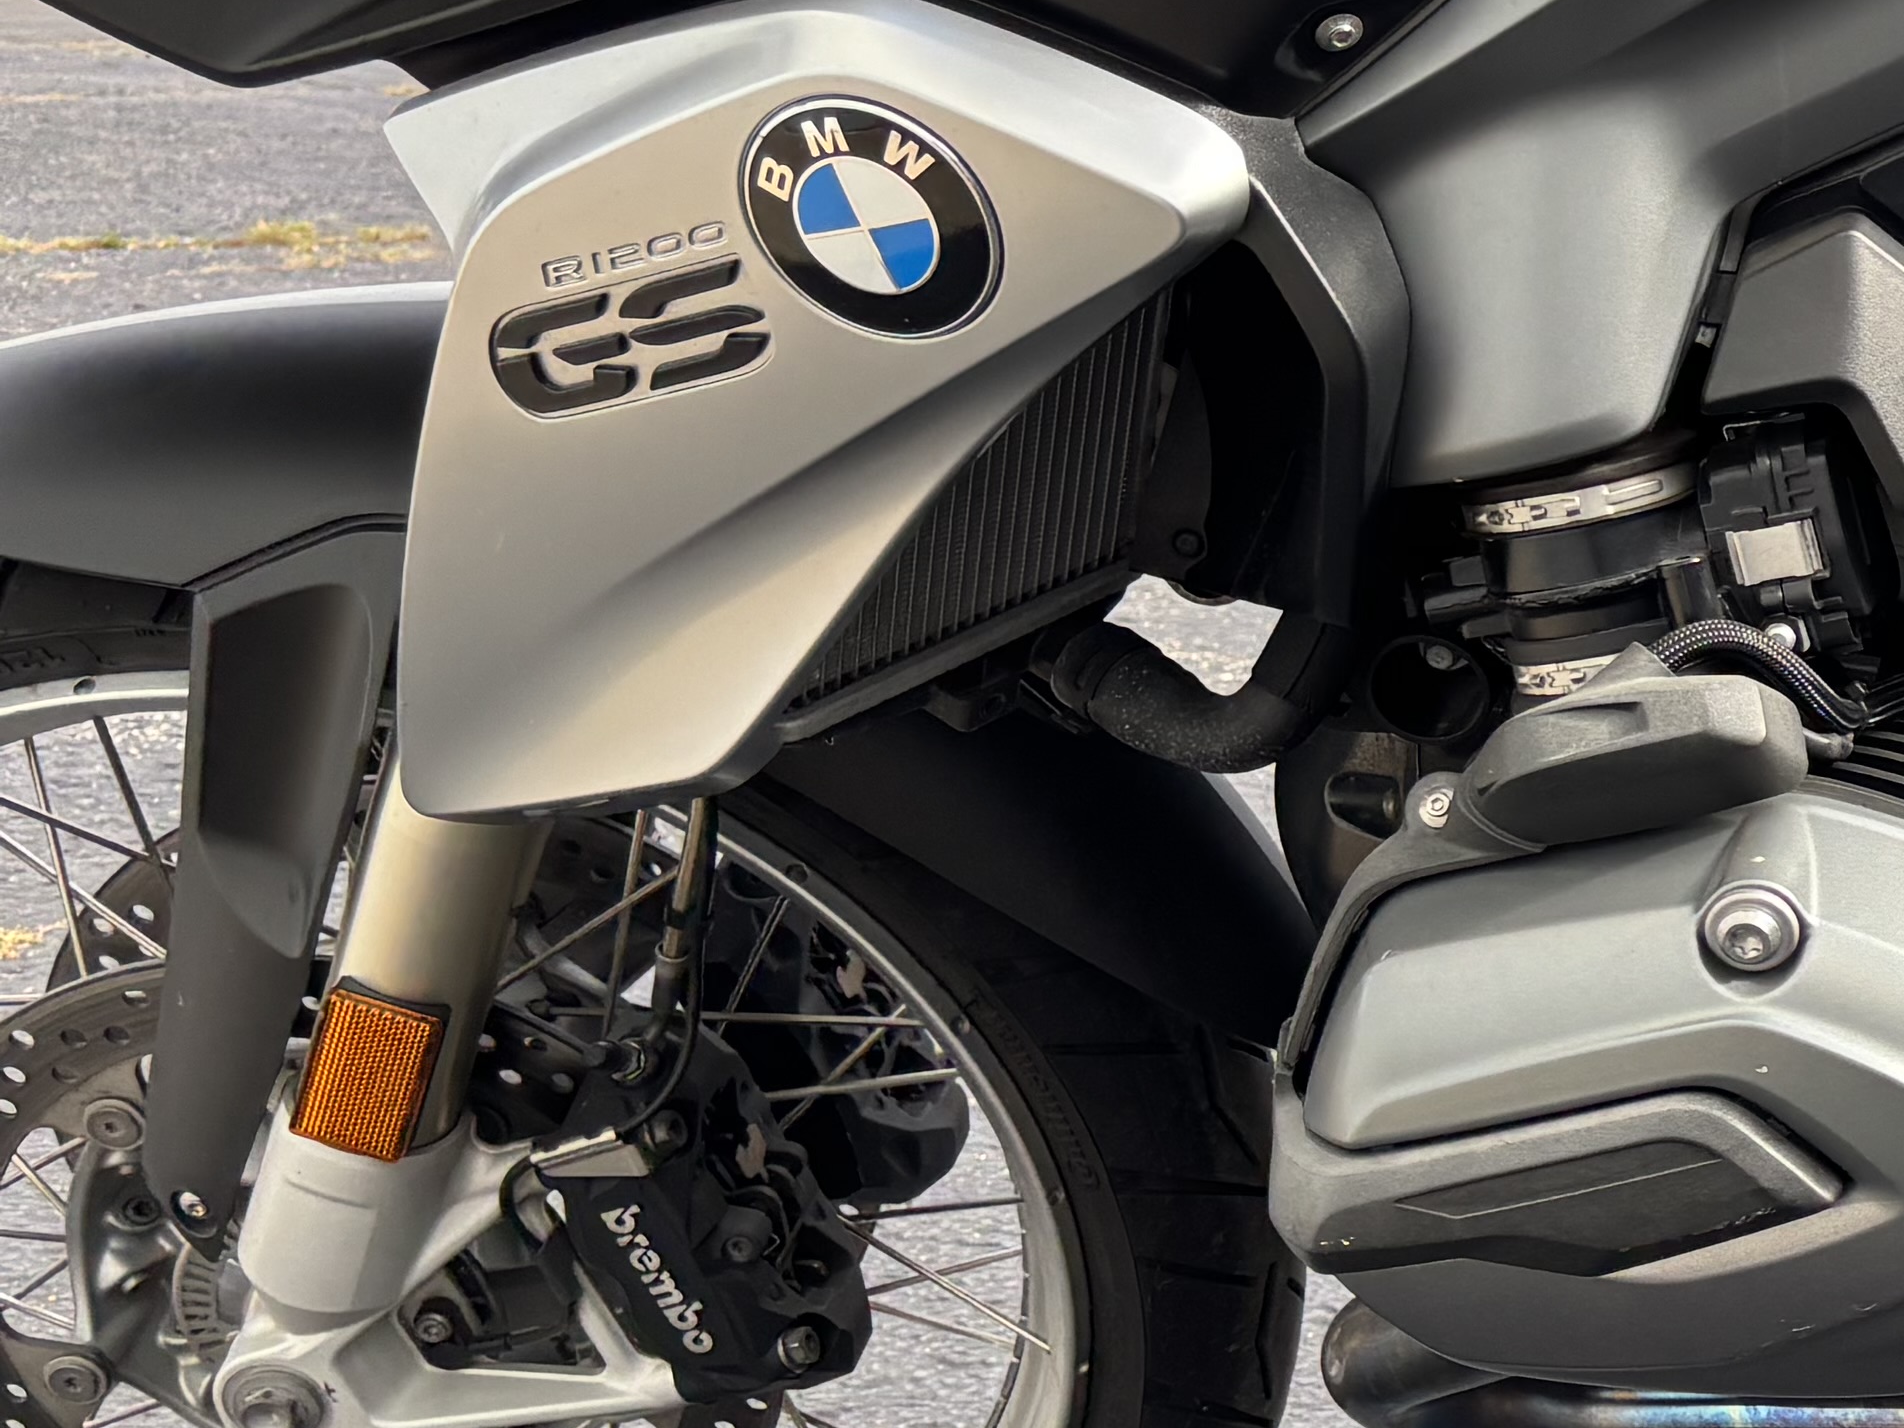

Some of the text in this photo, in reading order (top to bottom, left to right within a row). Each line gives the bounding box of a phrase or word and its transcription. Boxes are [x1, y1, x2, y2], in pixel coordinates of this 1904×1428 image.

[756, 115, 935, 203] BMW
[541, 220, 728, 288] R1200
[488, 252, 773, 415] GS
[600, 1204, 714, 1354] brembo
